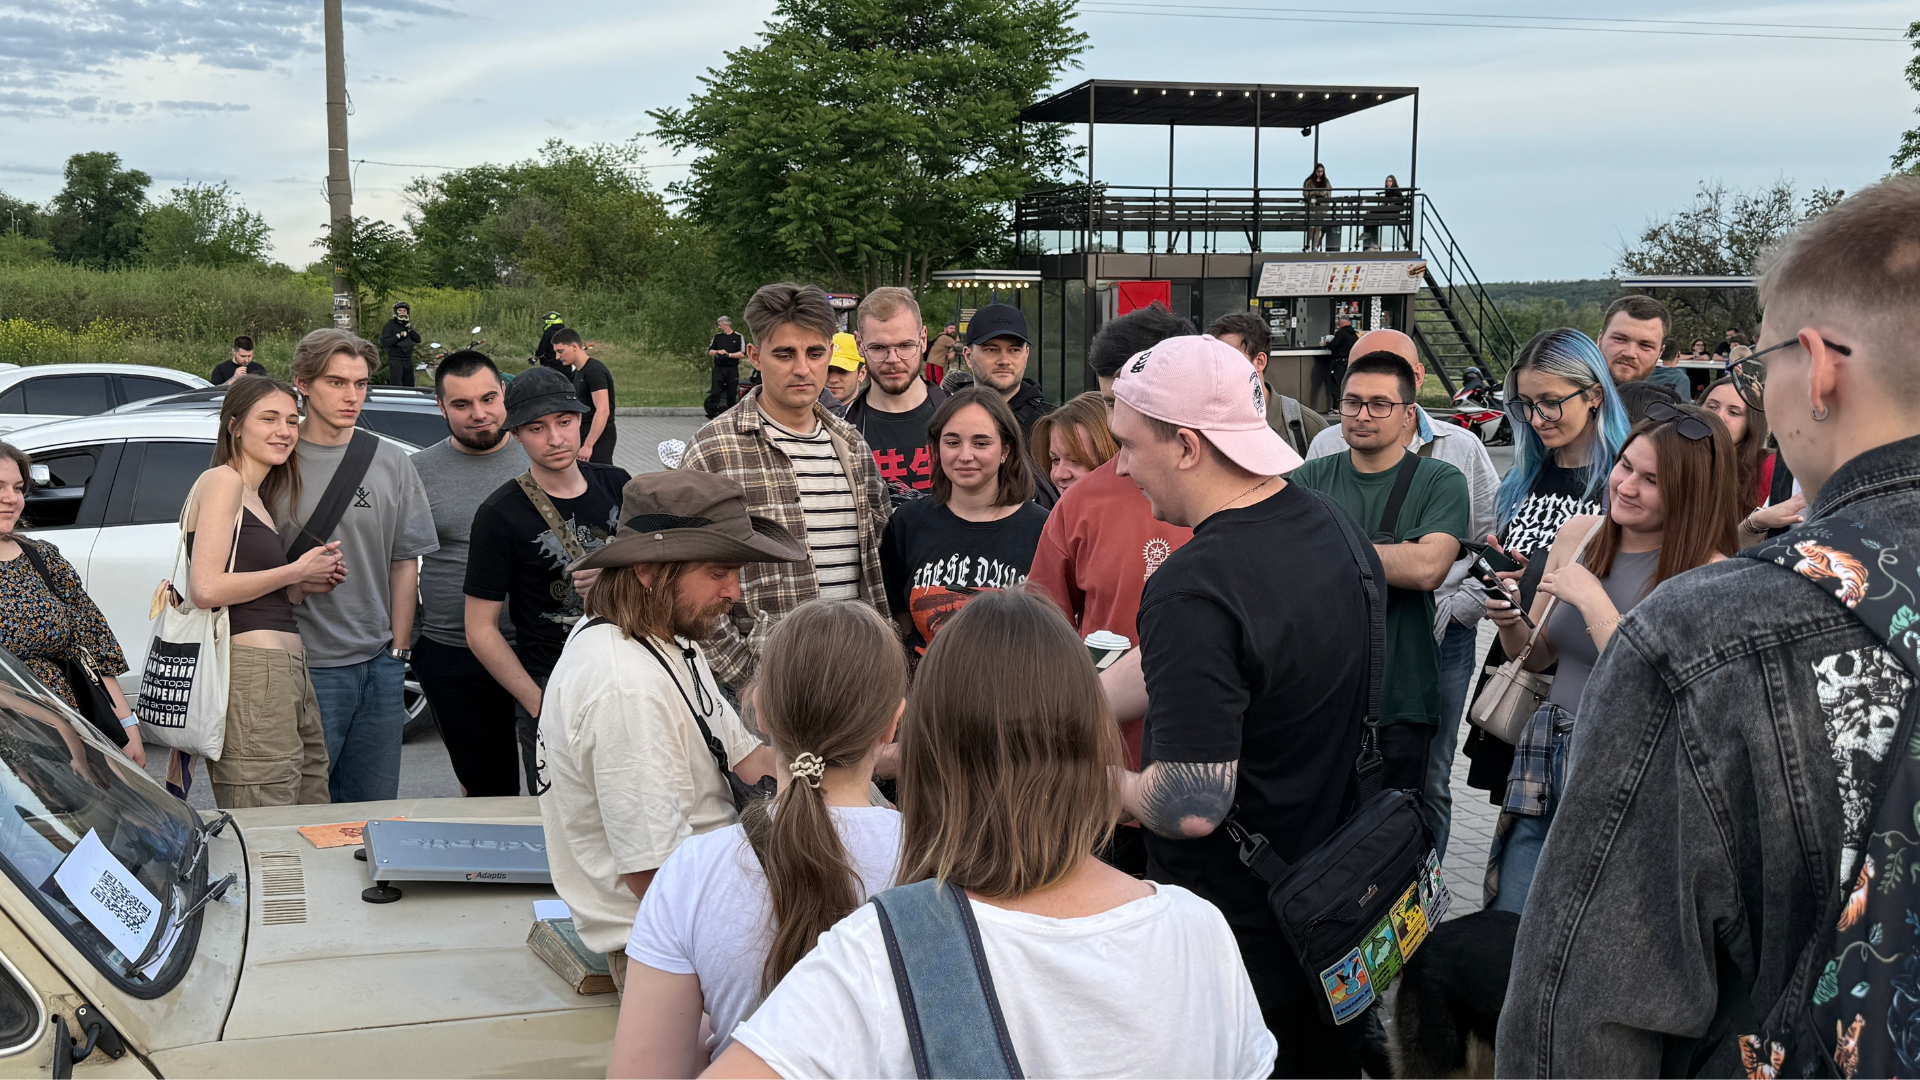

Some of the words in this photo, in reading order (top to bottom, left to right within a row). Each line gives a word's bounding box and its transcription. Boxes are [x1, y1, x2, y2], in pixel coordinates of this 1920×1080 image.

[154, 678, 190, 688] актора
[150, 702, 186, 712] актора
[475, 871, 507, 880] Adaptis
